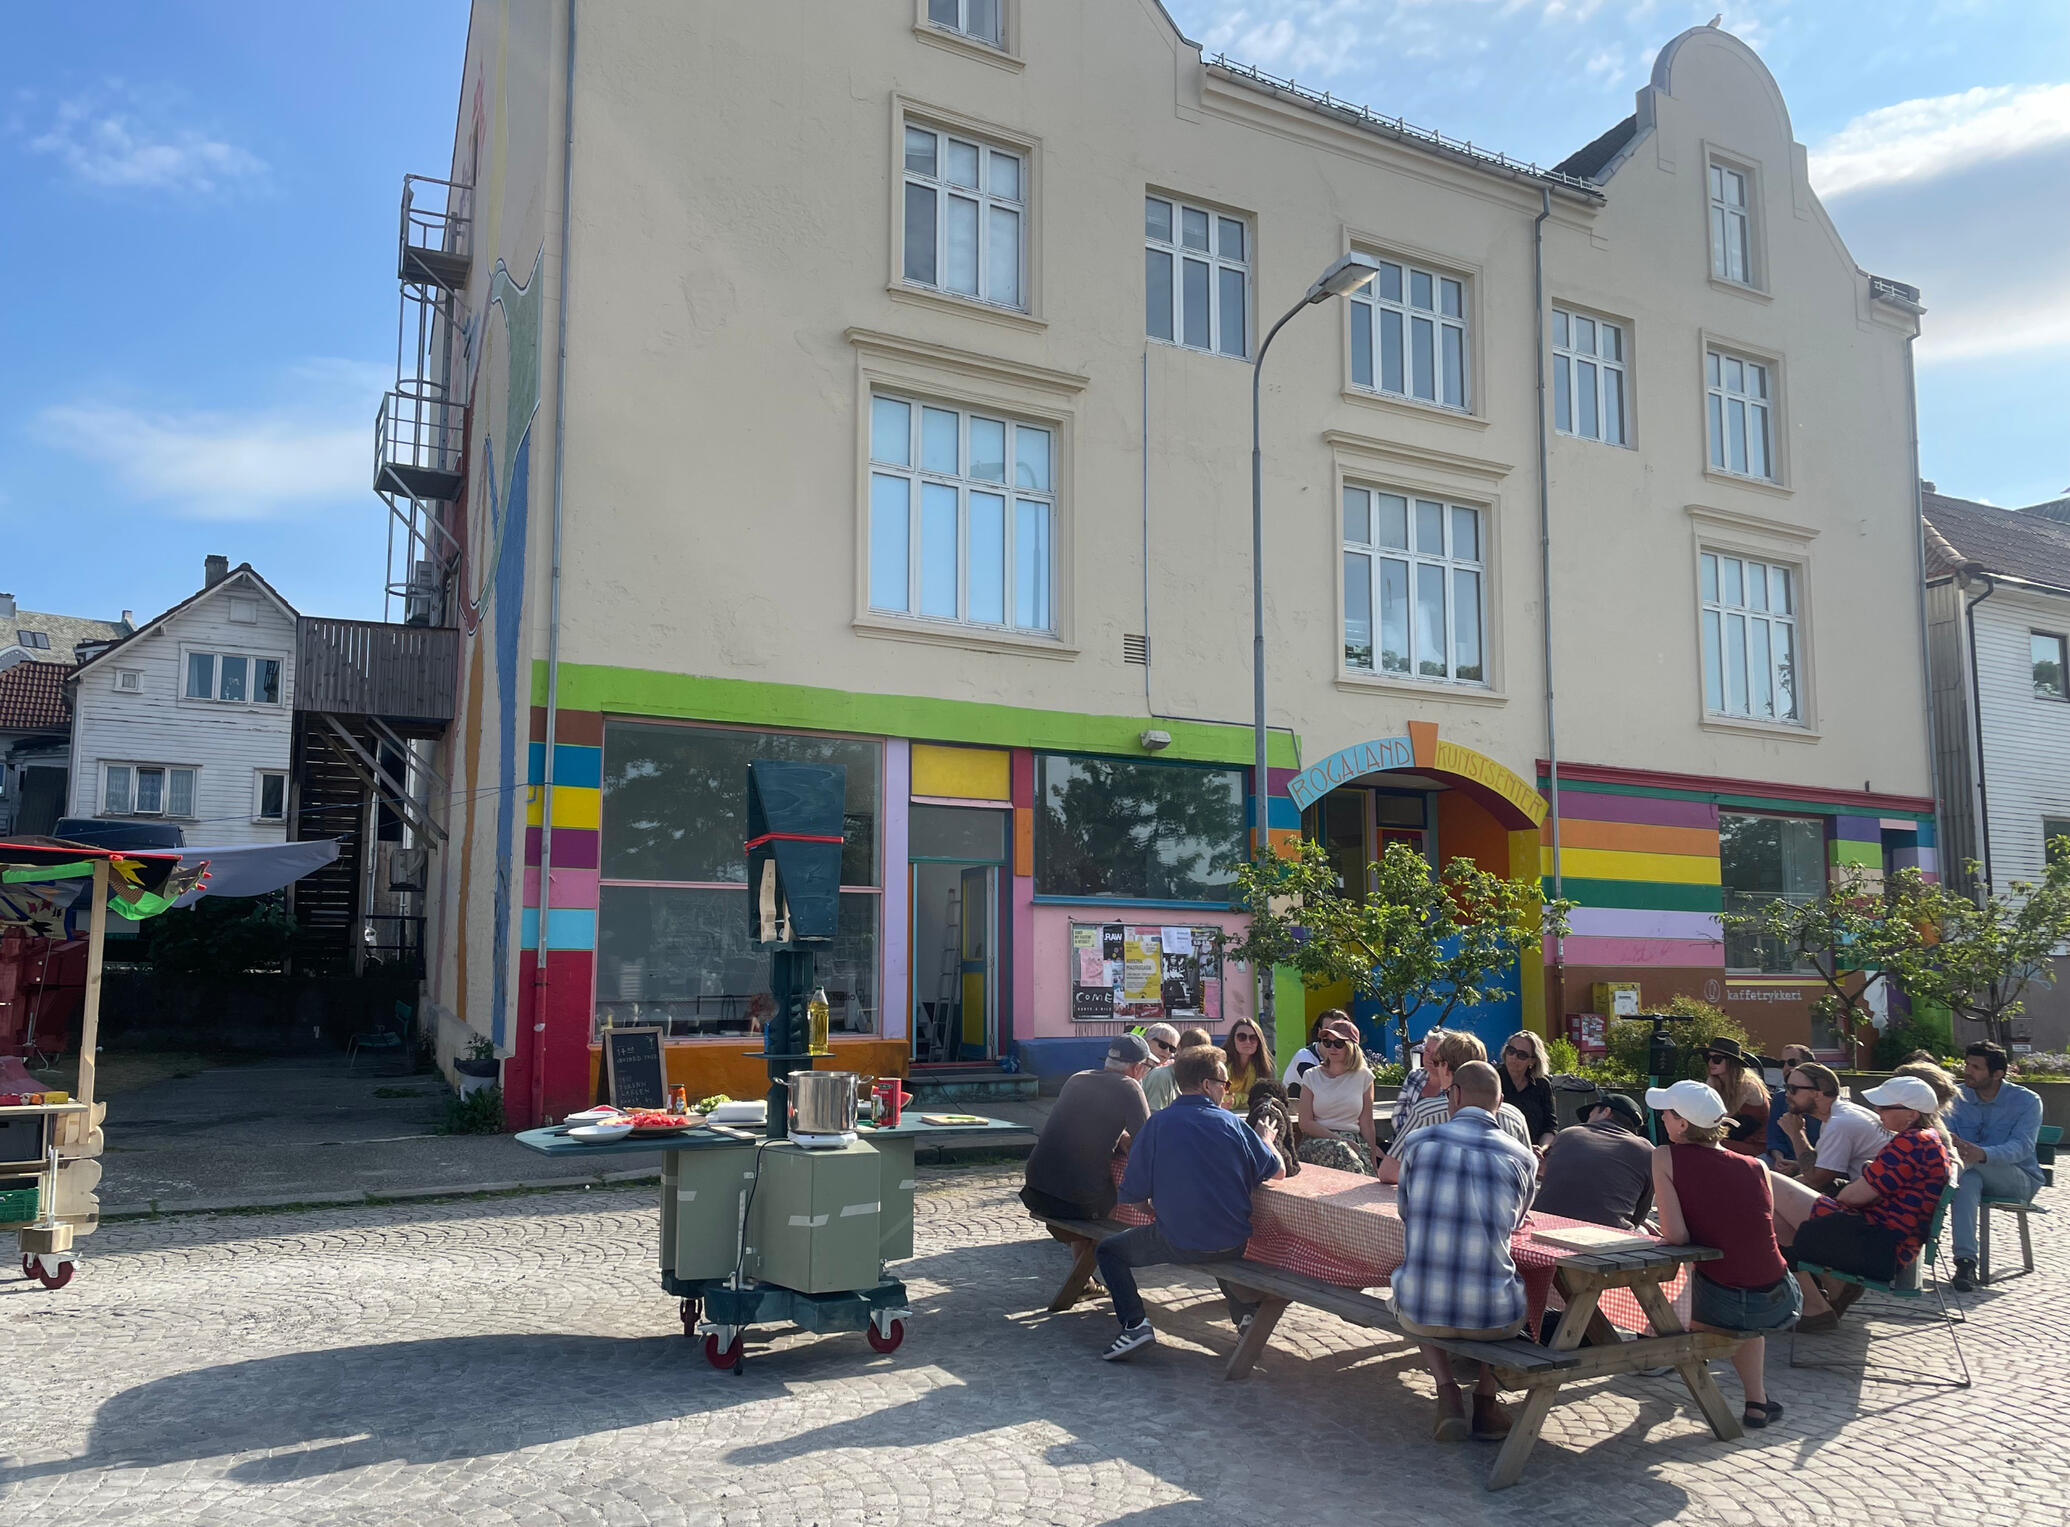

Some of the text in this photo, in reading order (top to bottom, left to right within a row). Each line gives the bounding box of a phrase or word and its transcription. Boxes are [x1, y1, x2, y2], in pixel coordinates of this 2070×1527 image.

[1291, 740, 1543, 819] ROGALAND KUNSTSENTER
[1727, 989, 1802, 1004] kaffetrykkeri
